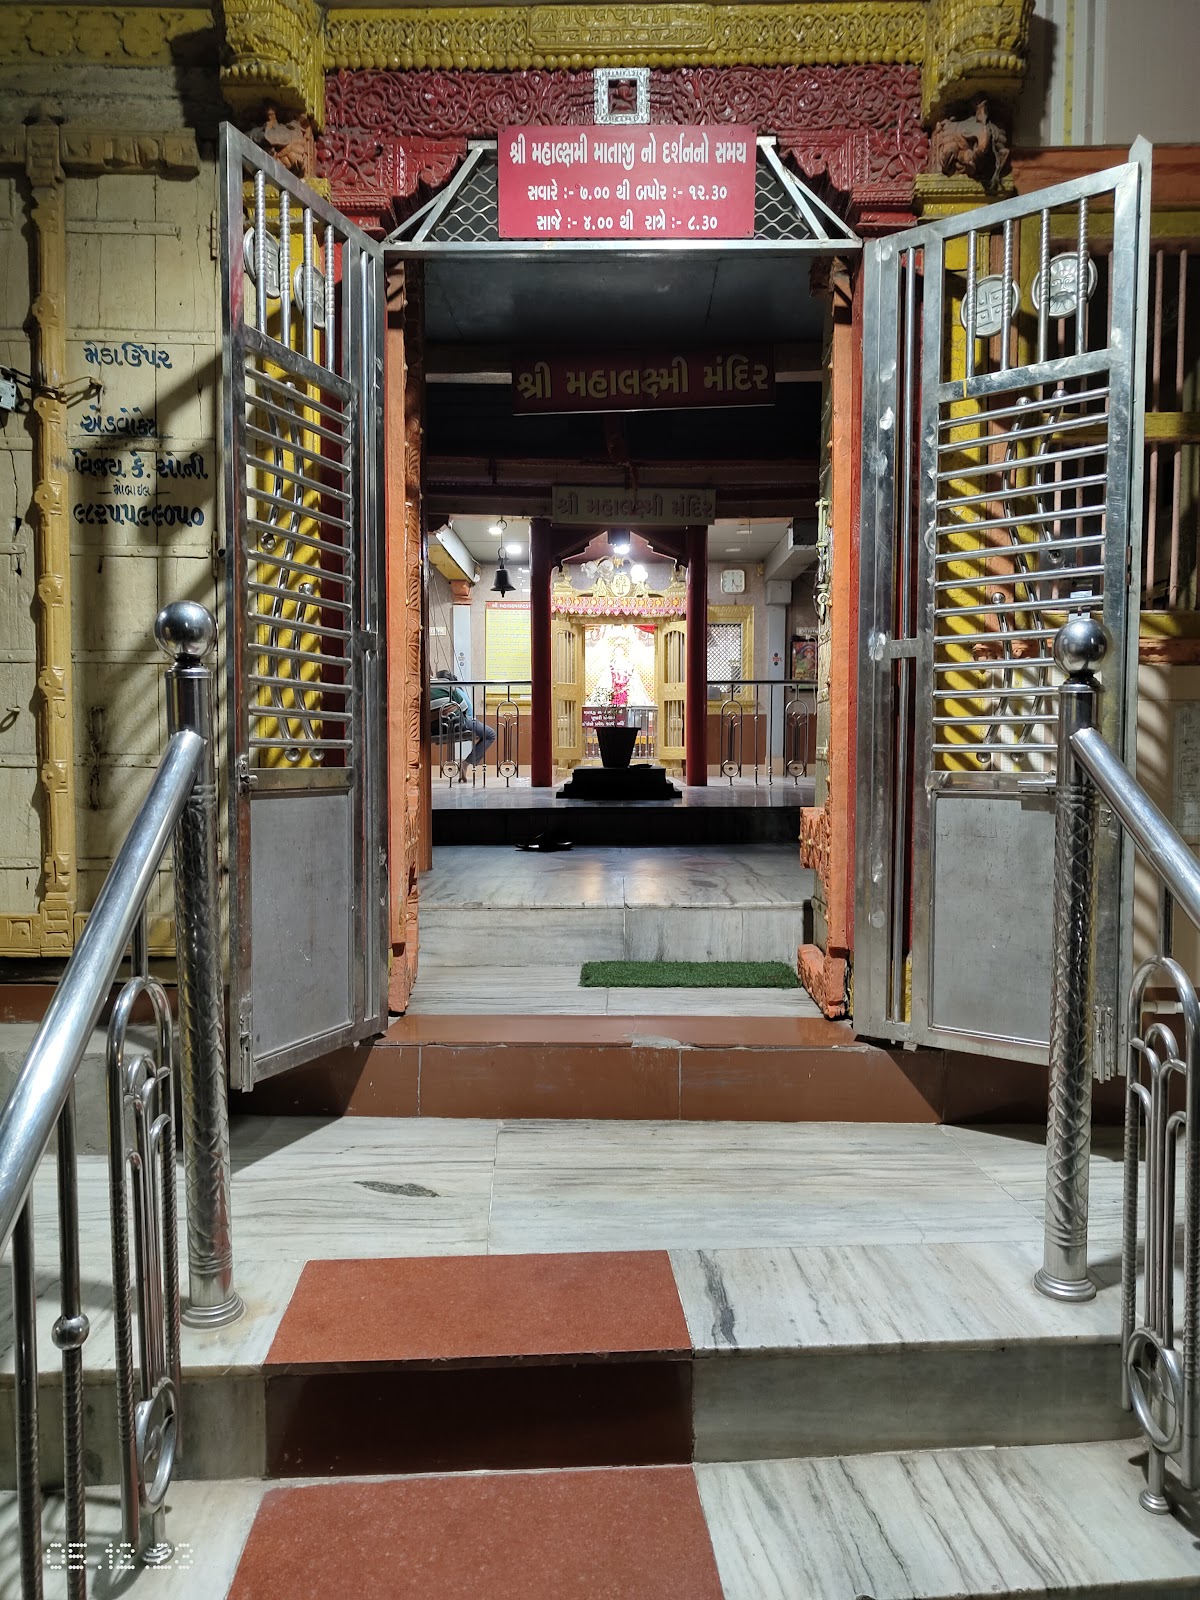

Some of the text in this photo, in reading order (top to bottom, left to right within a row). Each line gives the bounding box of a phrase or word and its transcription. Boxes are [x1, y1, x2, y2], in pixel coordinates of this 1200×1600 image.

[510, 132, 526, 164] શ્રી
[594, 141, 635, 171] માતાજી
[641, 132, 656, 164] નો
[715, 141, 747, 164] સમય
[527, 178, 558, 201] સવારે
[579, 186, 610, 201] ૭.૦૦
[616, 178, 630, 201] થી
[635, 178, 667, 201] બપોર
[688, 185, 728, 201] ૧૨.૩૦
[536, 208, 563, 231] સાજે
[583, 215, 614, 231] ૪.૦૦
[619, 208, 634, 231] થી
[644, 208, 666, 231] રાત્રે
[687, 215, 718, 231] ૮.૩૦
[516, 354, 769, 400] શ્રી મહાલક્ષ્મી મંદિર
[72, 448, 127, 476] વિજય
[558, 492, 579, 515] શ્રી
[671, 494, 713, 518] મંદિર
